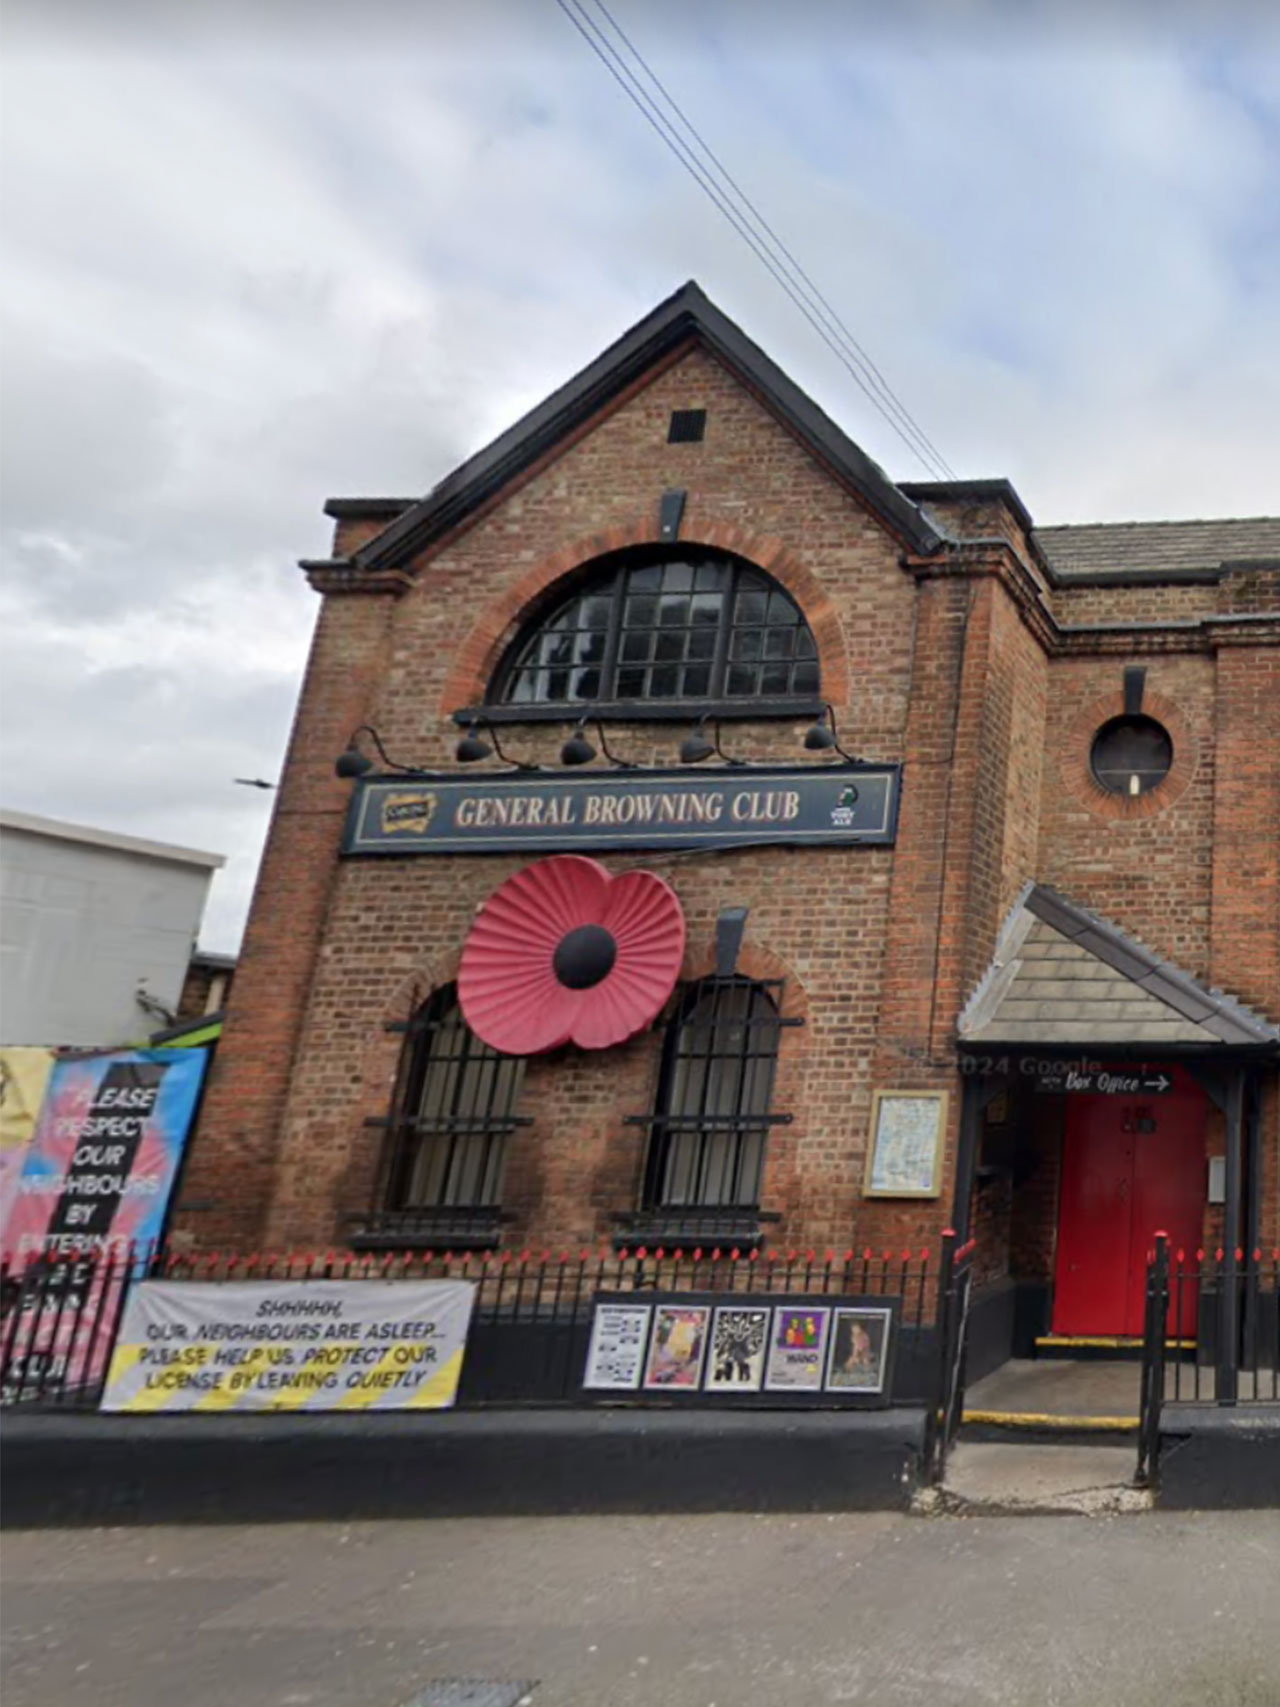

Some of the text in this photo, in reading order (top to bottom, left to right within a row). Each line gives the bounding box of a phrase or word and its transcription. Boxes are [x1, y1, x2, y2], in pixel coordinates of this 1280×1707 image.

[456, 796, 576, 827] GENERAL
[583, 792, 724, 824] BROWNING
[731, 790, 800, 820] CLUB
[1065, 1070, 1092, 1090] Box
[1097, 1071, 1139, 1094] Office
[75, 1087, 158, 1109] PLEASE
[56, 1116, 150, 1137] RESPECT
[74, 1145, 126, 1165] OUR
[20, 1174, 160, 1195] NEIGHBOURS
[65, 1203, 98, 1224] BY
[147, 1323, 187, 1341] OUR
[196, 1323, 322, 1341] NEIGHBOURS
[324, 1322, 361, 1340] ARE
[140, 1345, 437, 1365] PLEASE HELP US PROTECT OUR
[145, 1369, 428, 1390] LICENSE BY LEAVING QUIETLY
